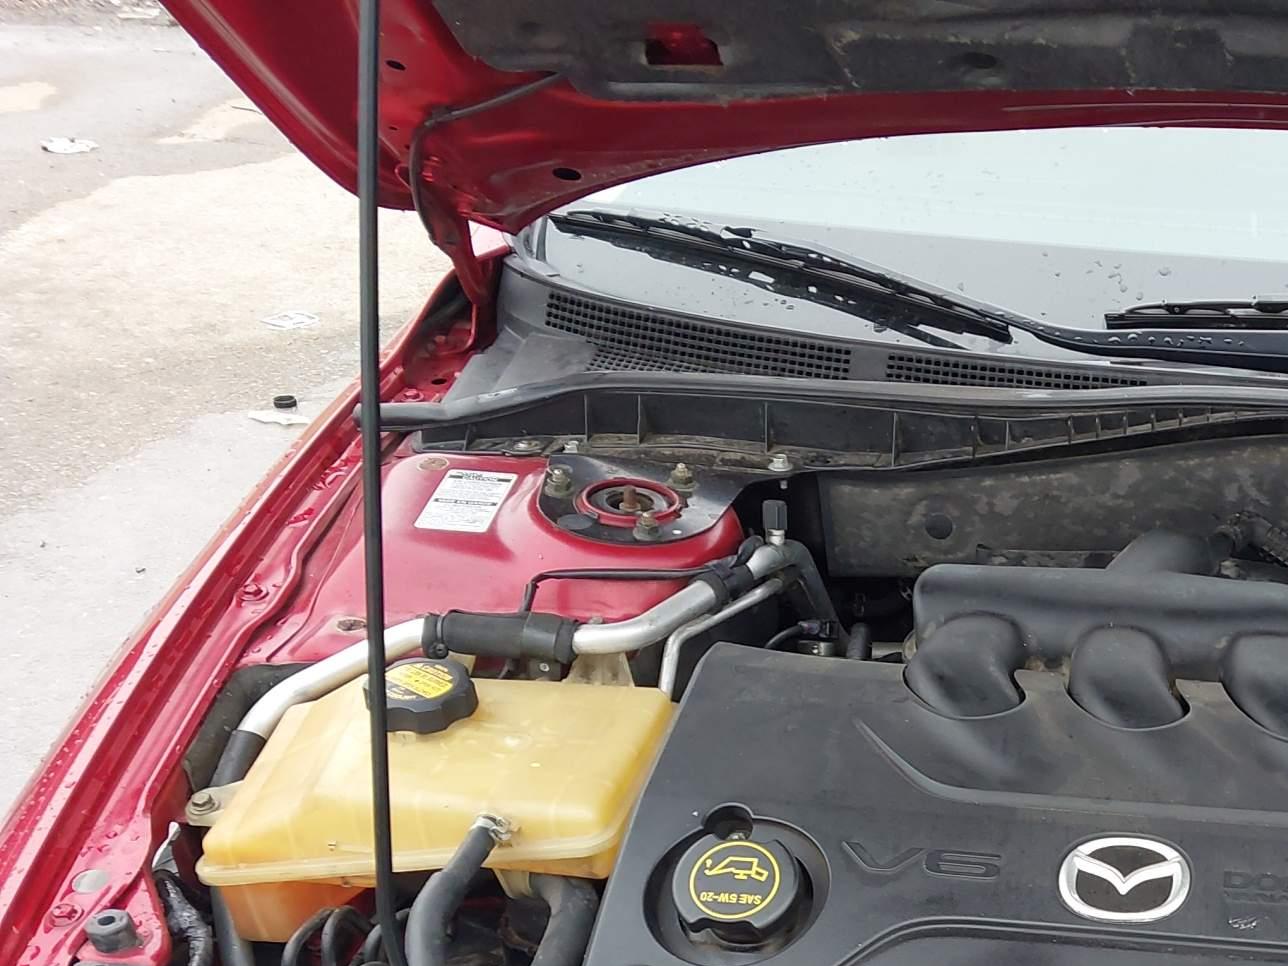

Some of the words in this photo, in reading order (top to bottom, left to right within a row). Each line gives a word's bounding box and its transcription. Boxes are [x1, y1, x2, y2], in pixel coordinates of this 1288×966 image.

[841, 840, 1002, 882] V6
[699, 890, 738, 904] 5W-20
[739, 893, 762, 905] SAE
